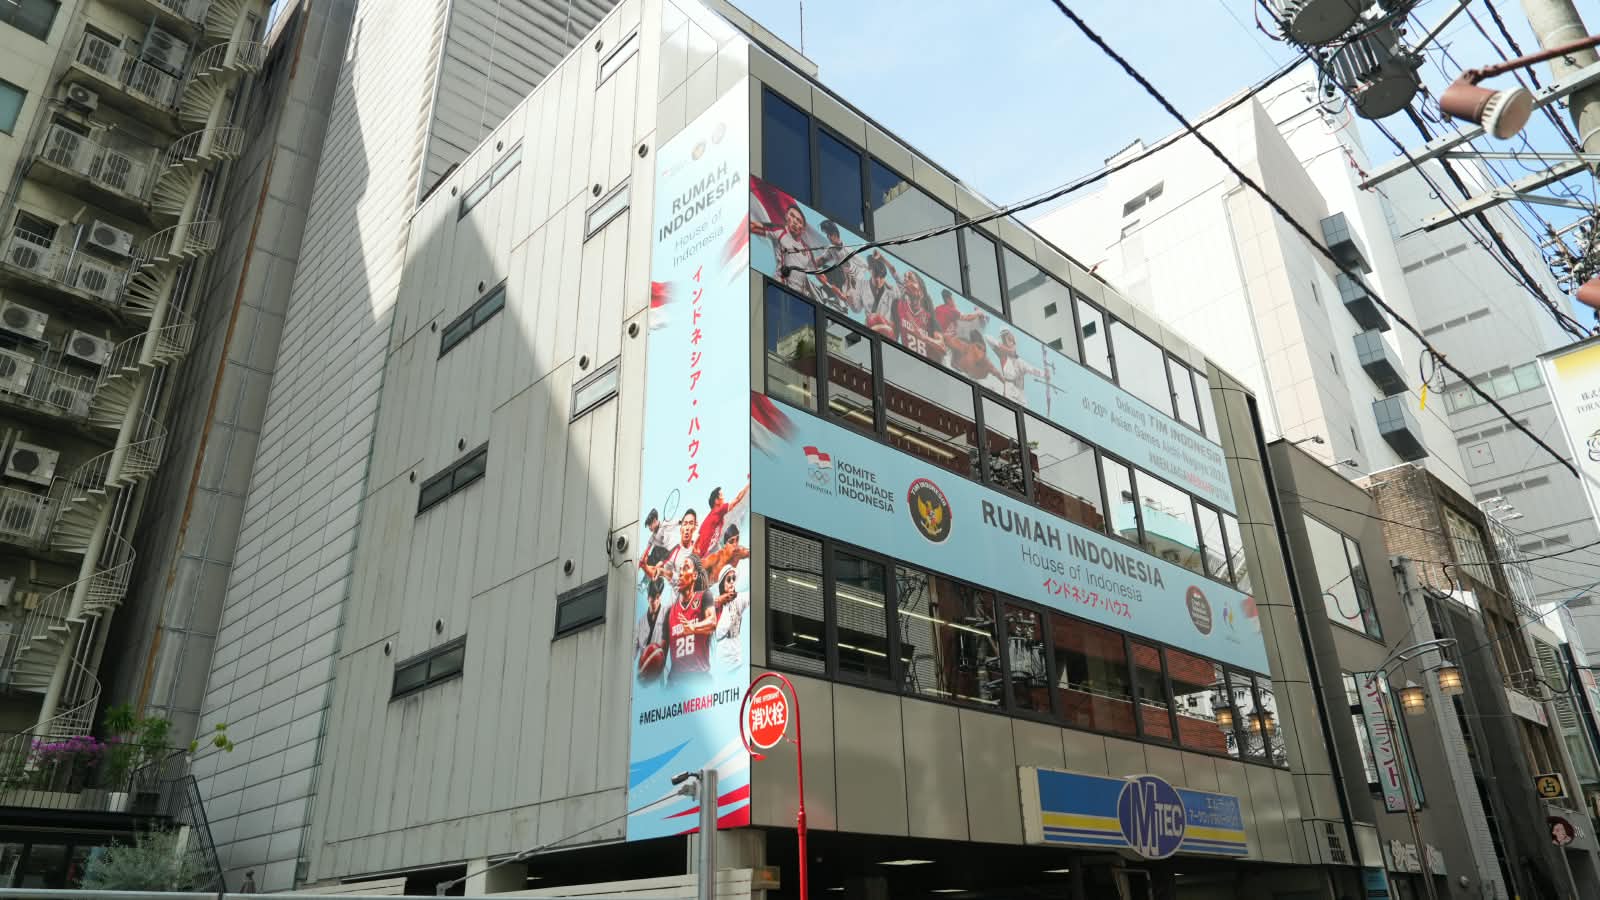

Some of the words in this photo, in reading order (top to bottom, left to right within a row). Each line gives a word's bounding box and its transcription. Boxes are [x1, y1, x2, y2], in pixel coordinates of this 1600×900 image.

[659, 171, 741, 243] INDONESIA
[672, 161, 728, 215] RUMAH
[673, 226, 724, 268] Indonesia
[675, 221, 709, 249] House
[712, 207, 722, 223] of
[687, 265, 703, 483] インドネシア・ハウス
[1134, 425, 1161, 449] Games
[1149, 414, 1168, 436] TIM
[837, 460, 877, 484] KOMITE
[838, 472, 895, 503] OLIMPIADE
[838, 484, 895, 514] INDONESIA
[981, 499, 1062, 551] RUMAH
[1067, 533, 1166, 590] INDONESIA
[1021, 545, 1065, 576] House
[1069, 563, 1081, 580] of
[1086, 568, 1143, 602] Indonesia
[1042, 577, 1132, 620] インドネシア・ハウス
[675, 633, 696, 659] 26
[639, 688, 740, 725] #MENJAGAMERAHPUTIH
[751, 701, 785, 732] 消火栓
